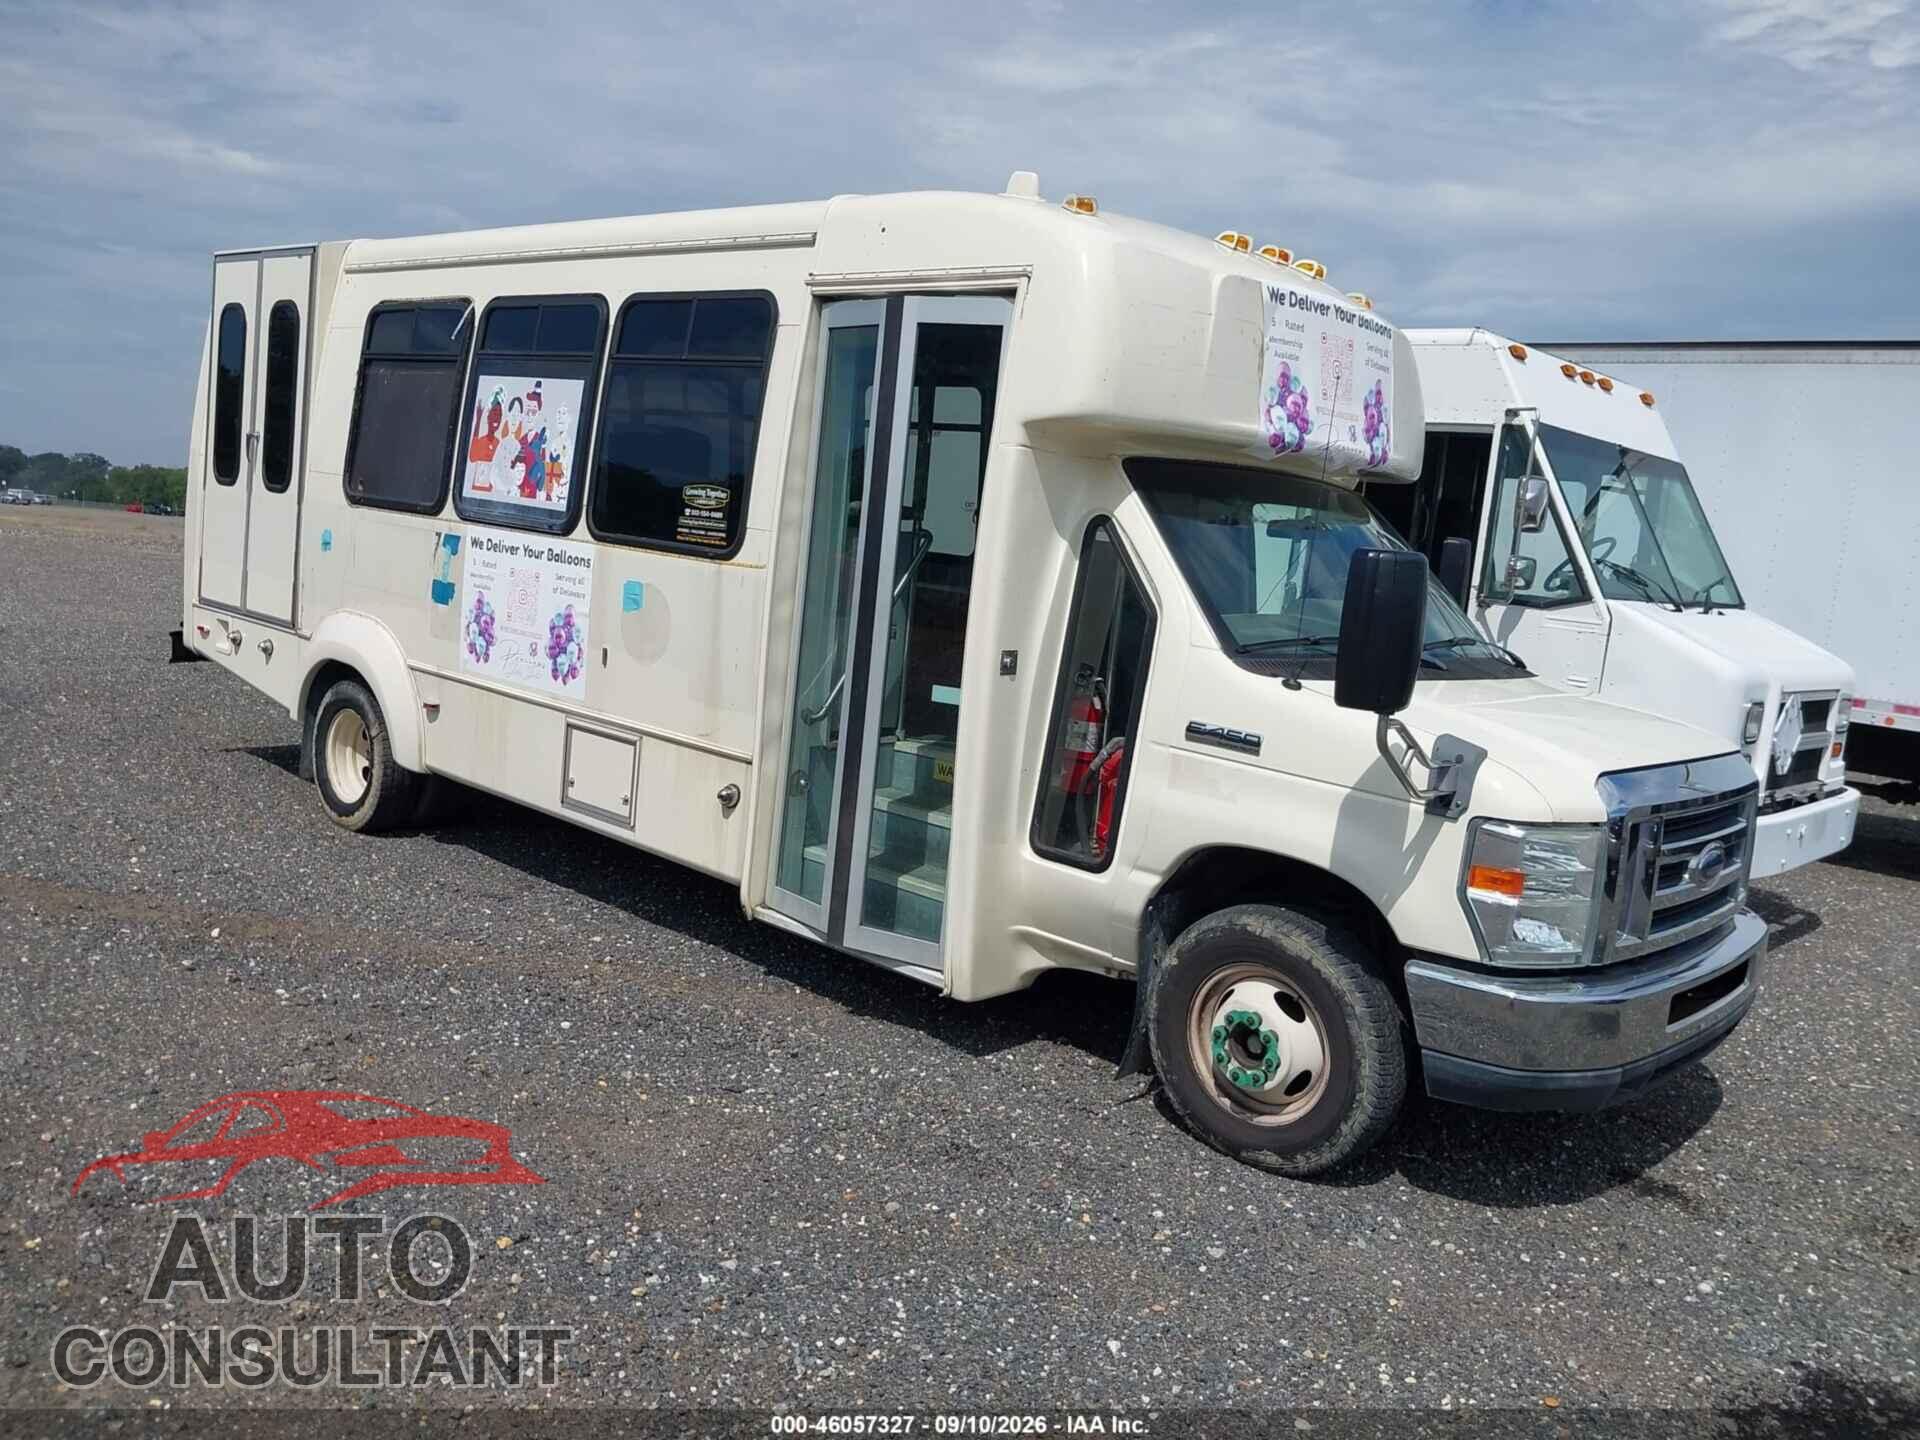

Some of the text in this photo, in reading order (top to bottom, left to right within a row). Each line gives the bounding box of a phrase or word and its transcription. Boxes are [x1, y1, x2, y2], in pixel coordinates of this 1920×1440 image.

[1266, 285, 1286, 306] We
[1289, 290, 1330, 317] Deliver
[1334, 303, 1356, 324] Your
[470, 535, 592, 569] We Deliver Your Balloons
